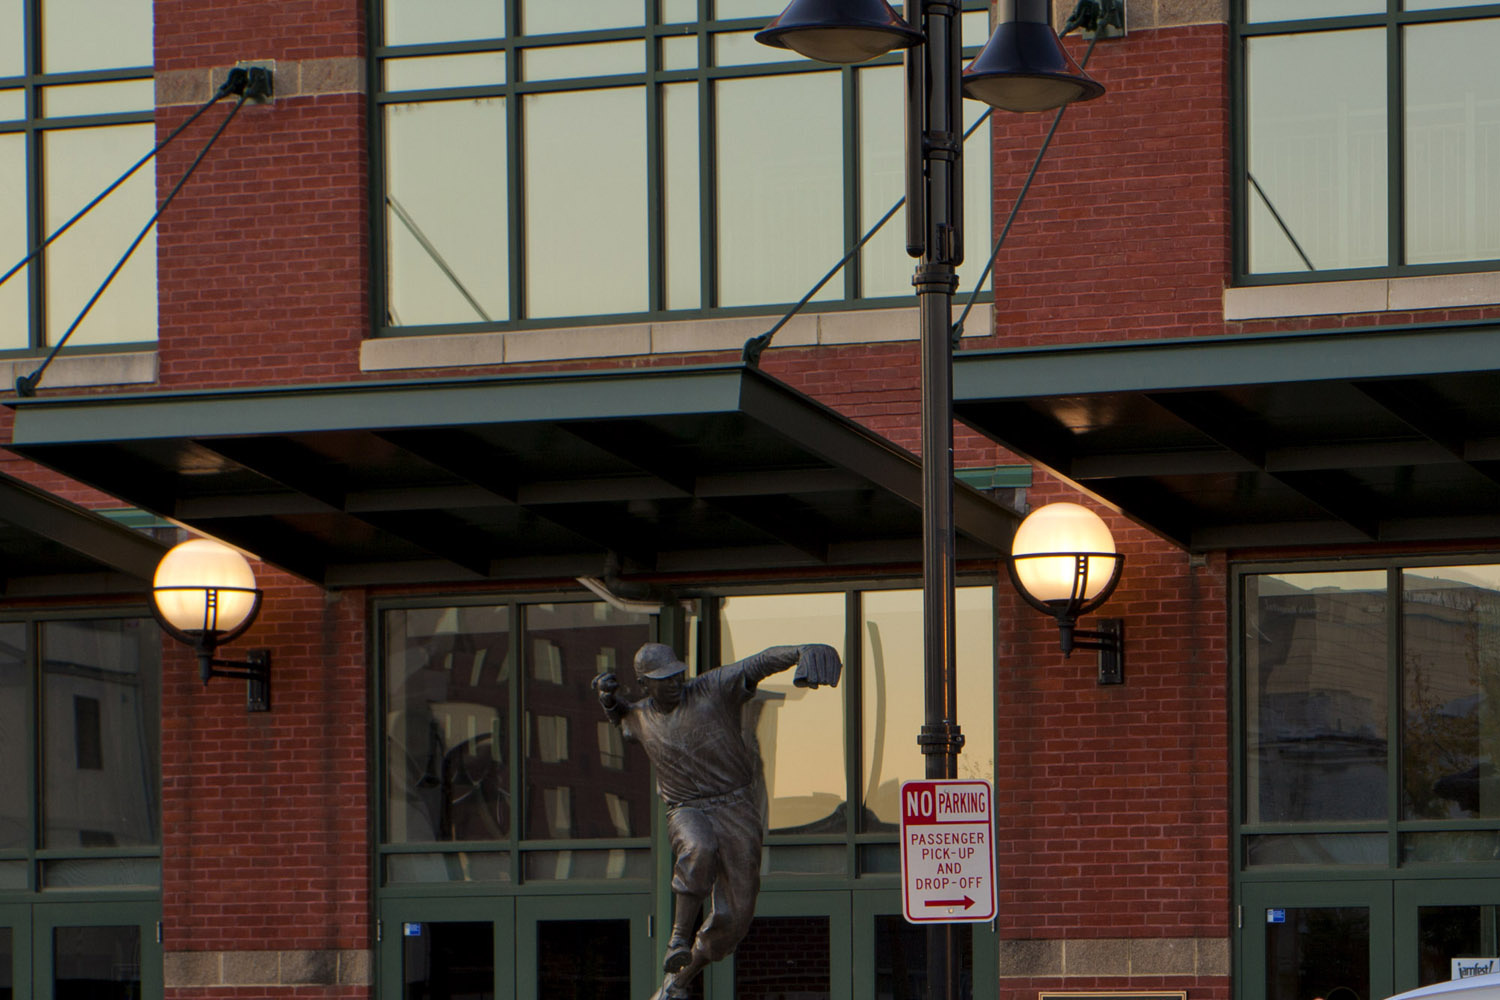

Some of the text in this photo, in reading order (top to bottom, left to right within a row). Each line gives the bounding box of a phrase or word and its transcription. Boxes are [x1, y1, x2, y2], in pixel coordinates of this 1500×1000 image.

[906, 790, 986, 817] NO PARKING
[911, 832, 985, 845] PASSENGER
[922, 847, 975, 860] PICK-UP
[936, 862, 962, 874] AND
[915, 876, 983, 890] DROP-OFF
